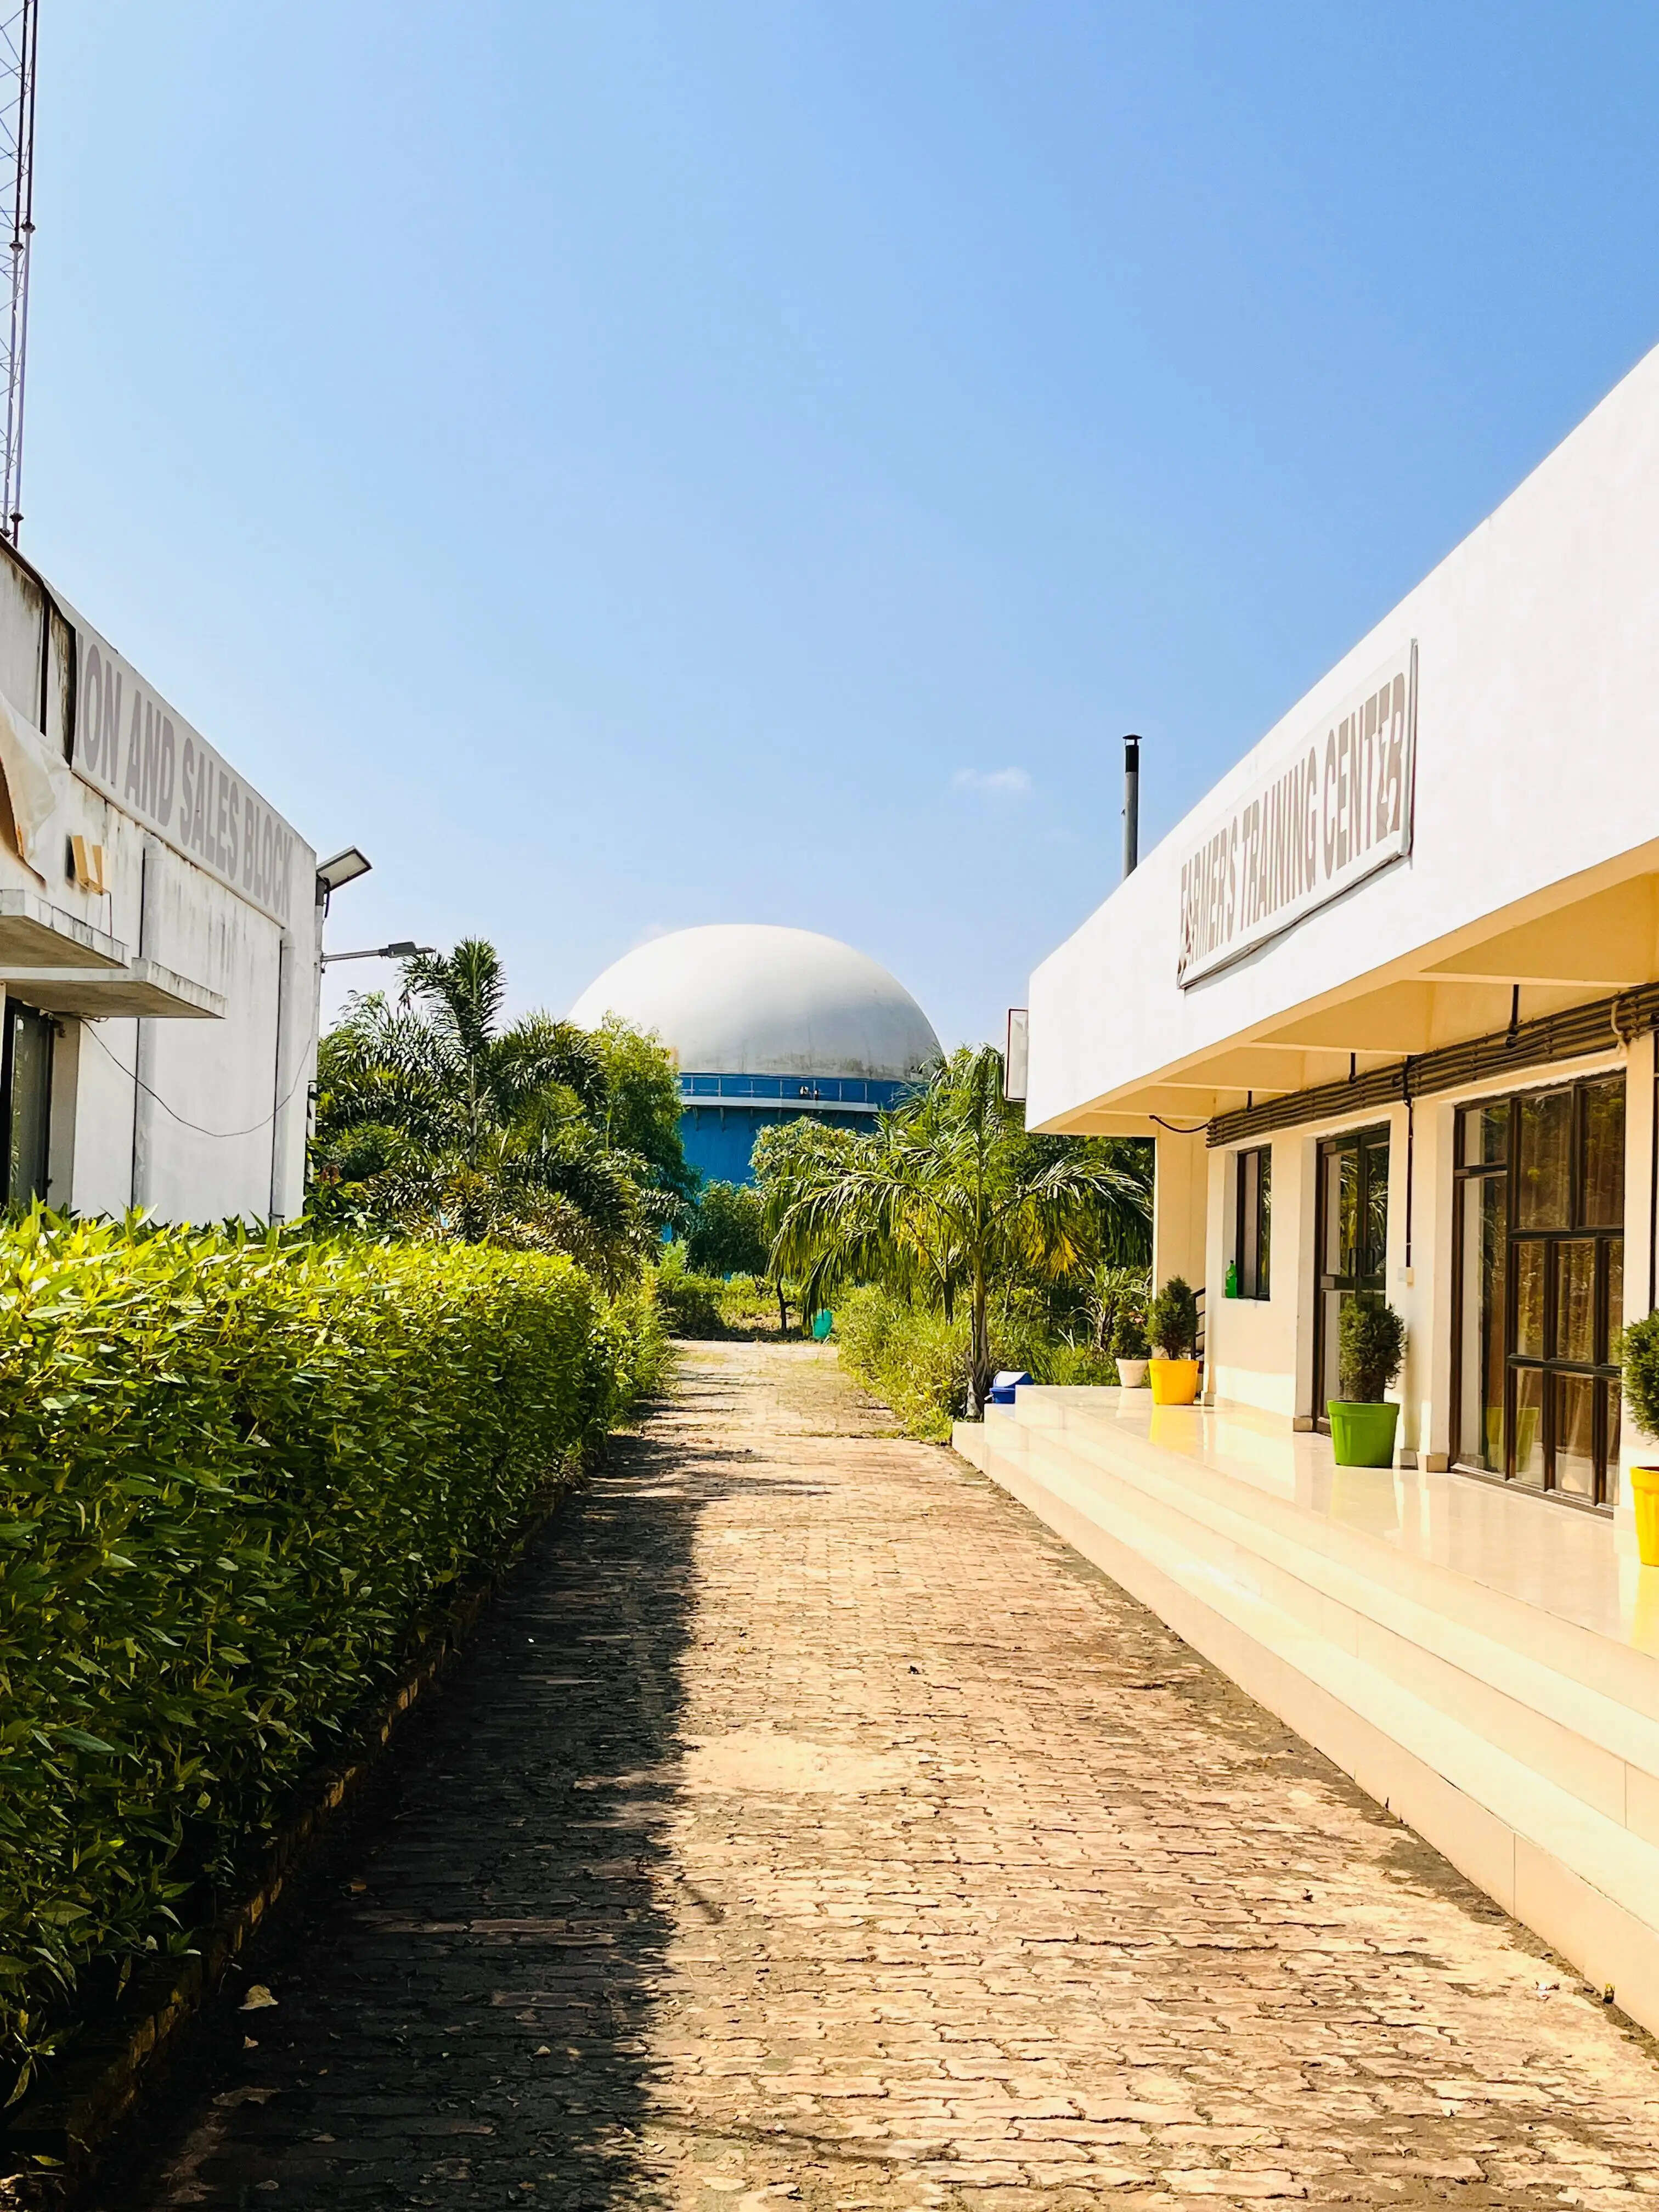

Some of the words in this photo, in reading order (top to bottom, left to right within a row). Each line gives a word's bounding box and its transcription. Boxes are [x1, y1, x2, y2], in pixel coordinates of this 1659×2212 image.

[124, 690, 175, 826] AND
[179, 737, 239, 881] SALES
[242, 796, 293, 924] BLOCK
[1239, 746, 1317, 932] TRAINING
[1324, 672, 1404, 880] CENTER
